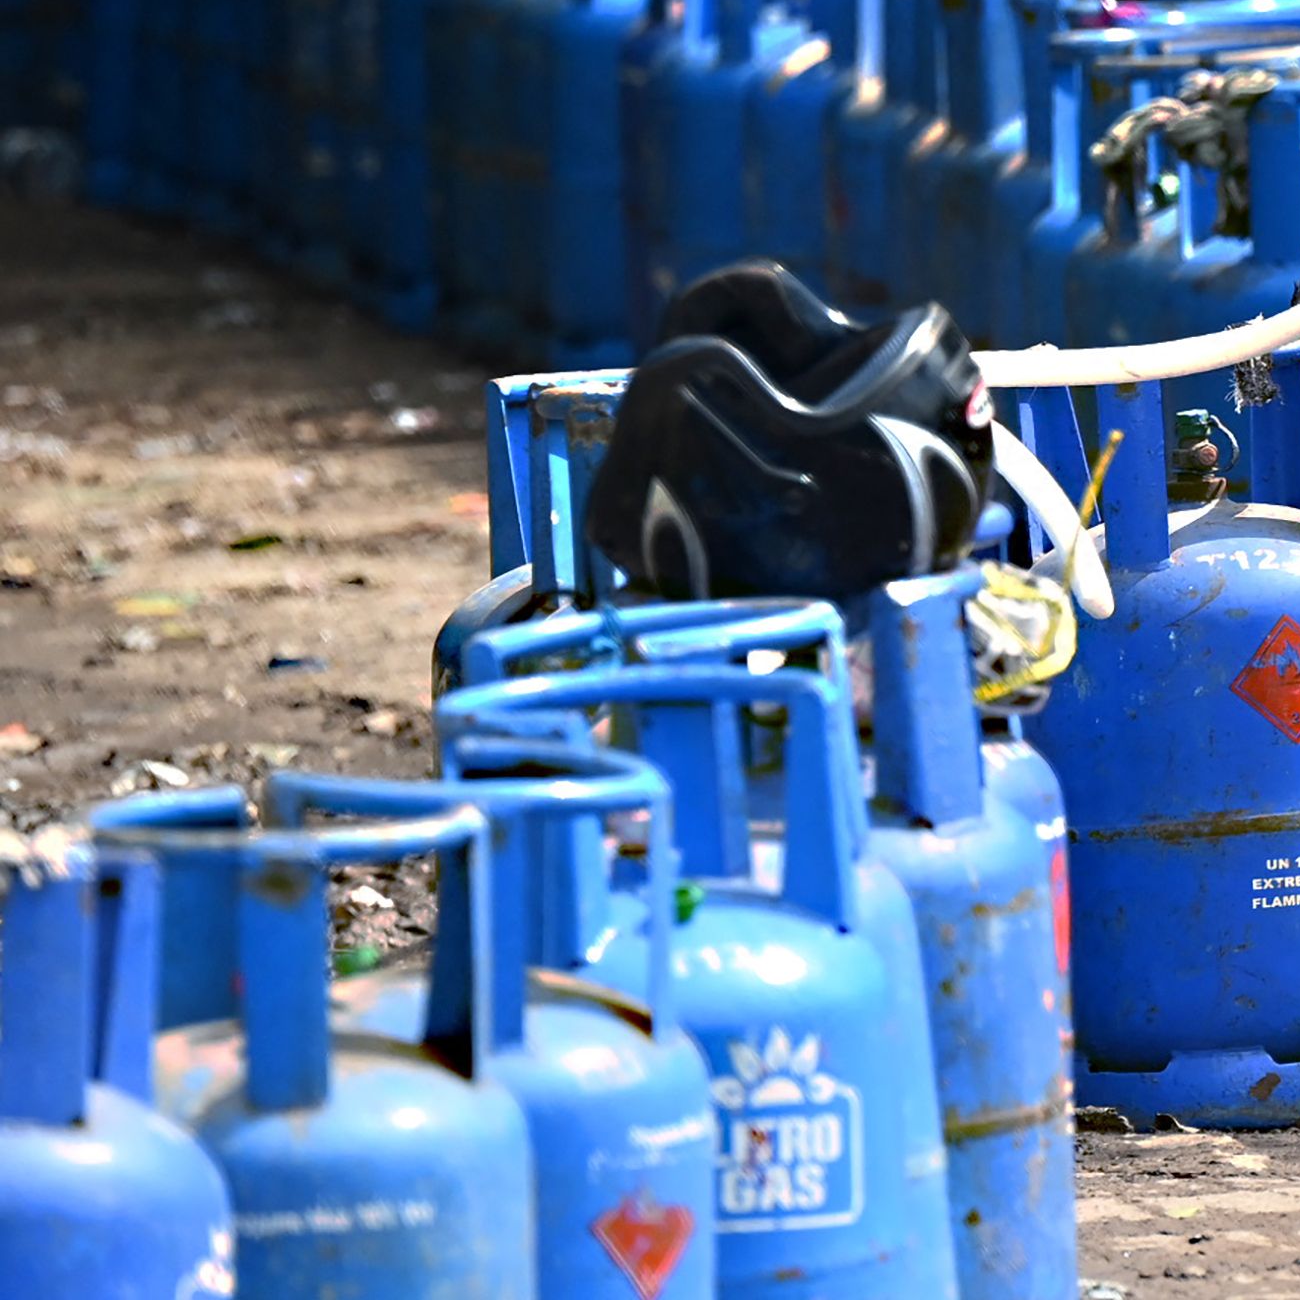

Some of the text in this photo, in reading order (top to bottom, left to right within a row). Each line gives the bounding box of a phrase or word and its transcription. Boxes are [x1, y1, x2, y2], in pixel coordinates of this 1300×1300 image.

[1266, 858, 1290, 870] UN
[718, 1113, 842, 1168] ITRO
[722, 1164, 826, 1214] GAS
